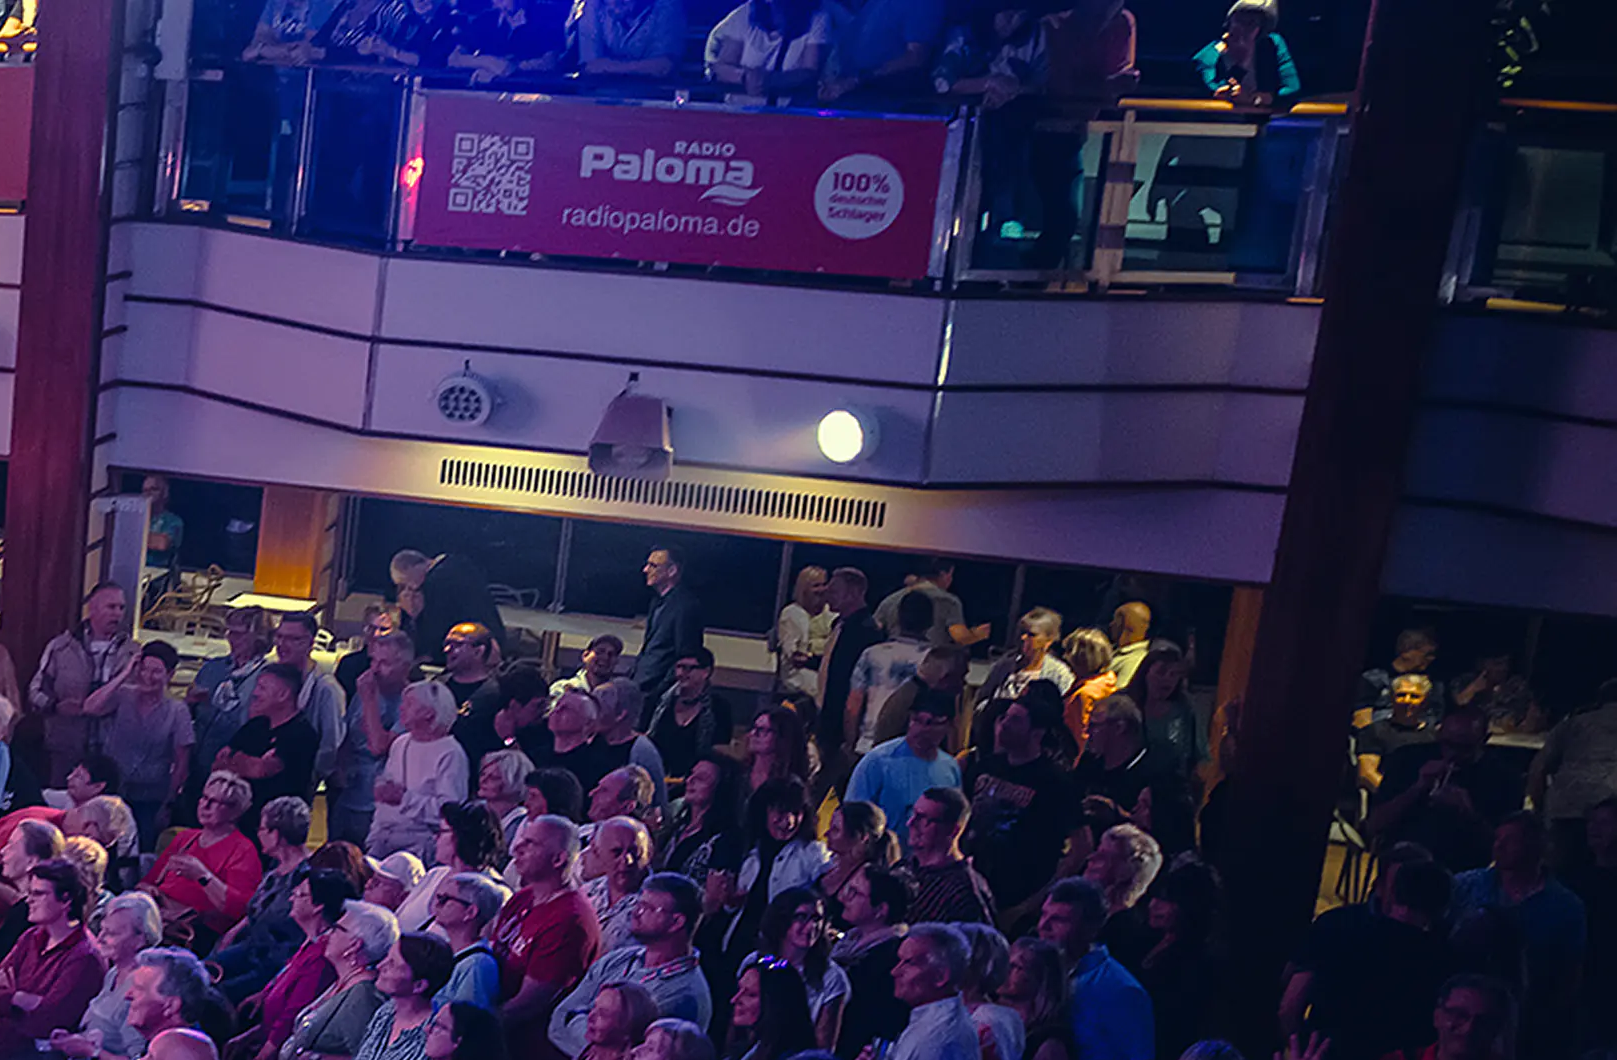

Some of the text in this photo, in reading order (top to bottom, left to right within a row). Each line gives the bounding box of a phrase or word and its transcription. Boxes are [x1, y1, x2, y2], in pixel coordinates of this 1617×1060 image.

[673, 140, 736, 157] RADIO
[580, 145, 754, 188] Paloma
[832, 171, 891, 194] 100%
[561, 204, 760, 238] radiopaloma.de
